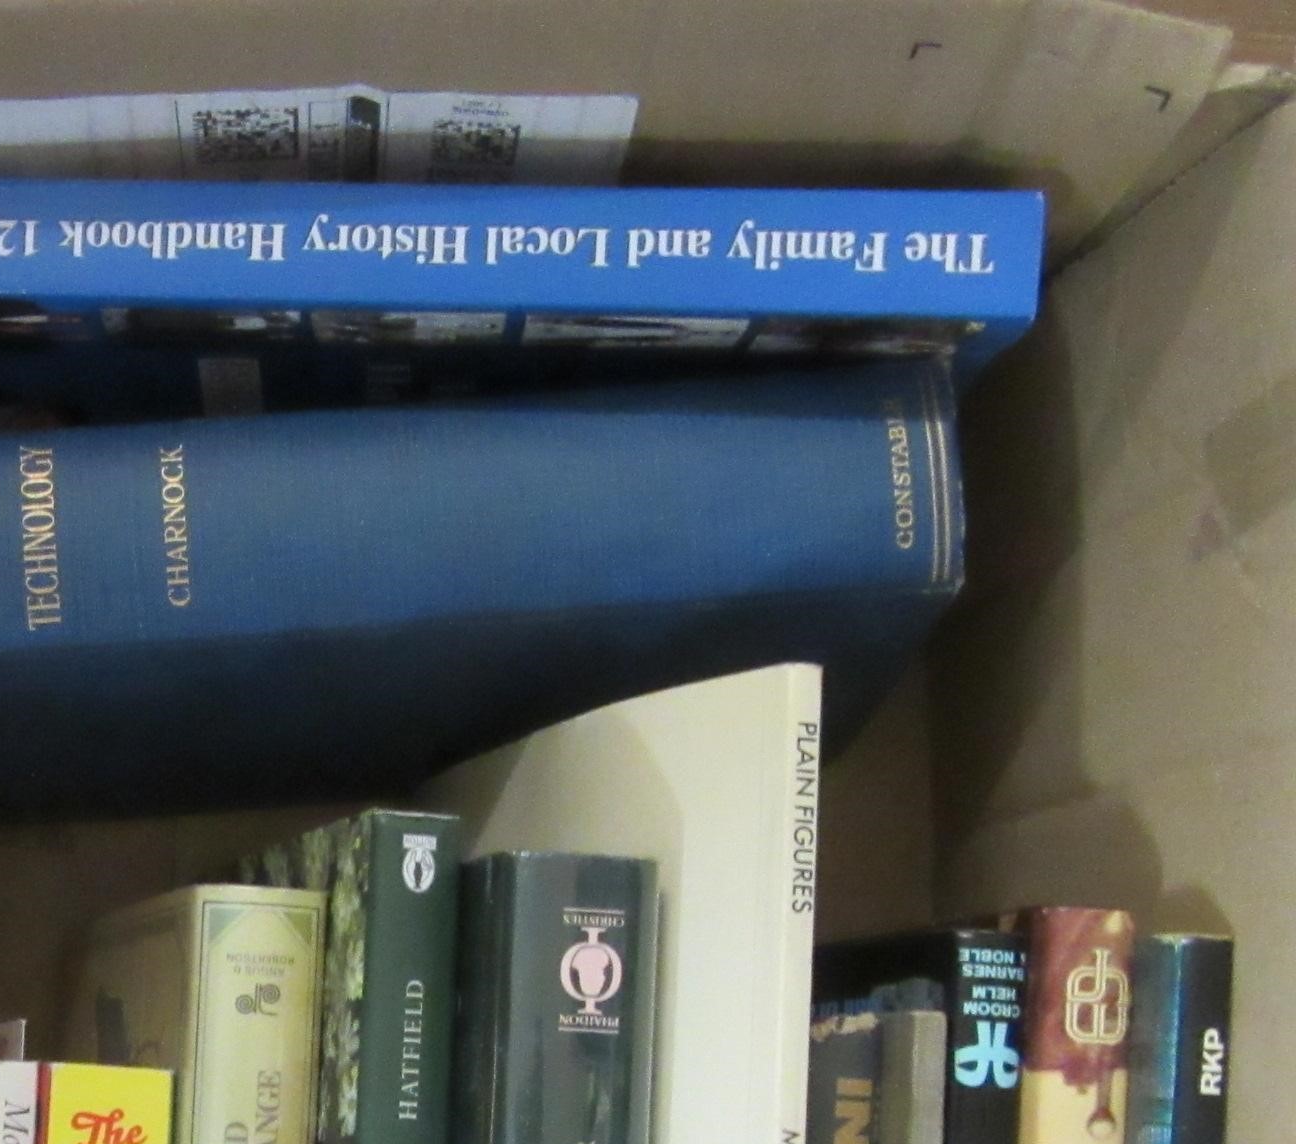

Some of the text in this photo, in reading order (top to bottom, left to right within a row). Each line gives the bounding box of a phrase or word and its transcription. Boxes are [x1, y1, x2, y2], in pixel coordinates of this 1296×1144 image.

[60, 219, 285, 261] Handbook
[303, 213, 467, 265] History
[487, 224, 609, 266] Local
[629, 226, 709, 256] and
[726, 220, 889, 272] Family
[905, 231, 995, 273] The
[20, 445, 61, 631] TECHNOLOGY
[159, 444, 192, 608] CHARNOCK
[792, 721, 817, 915] PLAIN FIGURES
[958, 946, 1015, 965] NOBLE
[962, 963, 1026, 982] BARNES
[962, 1001, 1022, 1018] CROOM
[972, 985, 1018, 1001] HELM
[559, 1013, 621, 1029] PHAIDON
[398, 979, 424, 1121] HATFIELD
[1200, 1028, 1226, 1096] RKP
